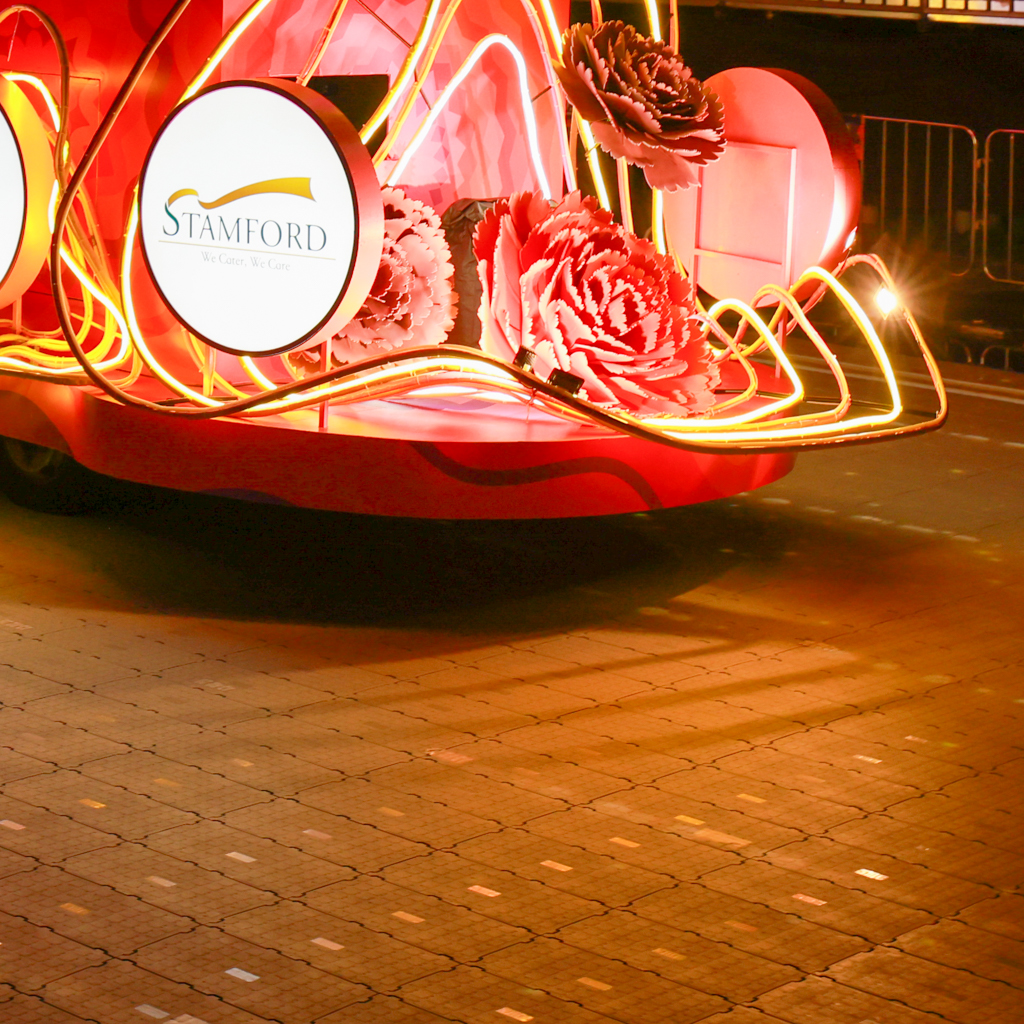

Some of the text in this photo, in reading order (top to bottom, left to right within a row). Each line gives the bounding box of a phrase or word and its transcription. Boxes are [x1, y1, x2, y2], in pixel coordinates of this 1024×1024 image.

[162, 200, 328, 252] STAMFORD
[200, 250, 291, 271] We Cater, We Care
